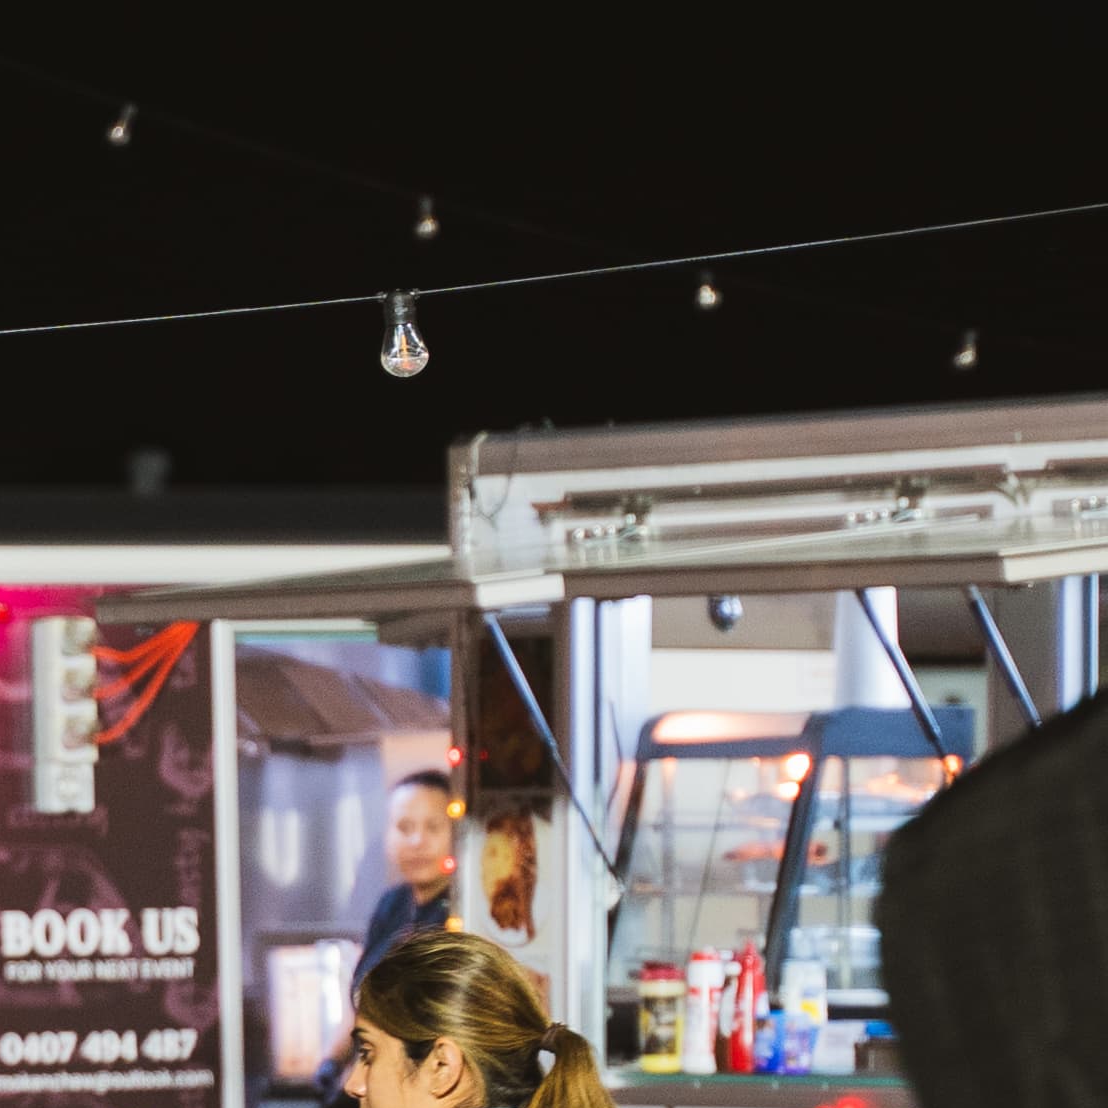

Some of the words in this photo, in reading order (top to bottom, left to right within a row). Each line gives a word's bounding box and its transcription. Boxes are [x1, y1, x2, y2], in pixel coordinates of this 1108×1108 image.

[0, 907, 132, 957] BOOK
[142, 906, 200, 956] US
[5, 960, 42, 981] FOR
[43, 959, 92, 981] YOUR
[93, 958, 139, 980] NEXT
[141, 957, 194, 979] EVENT
